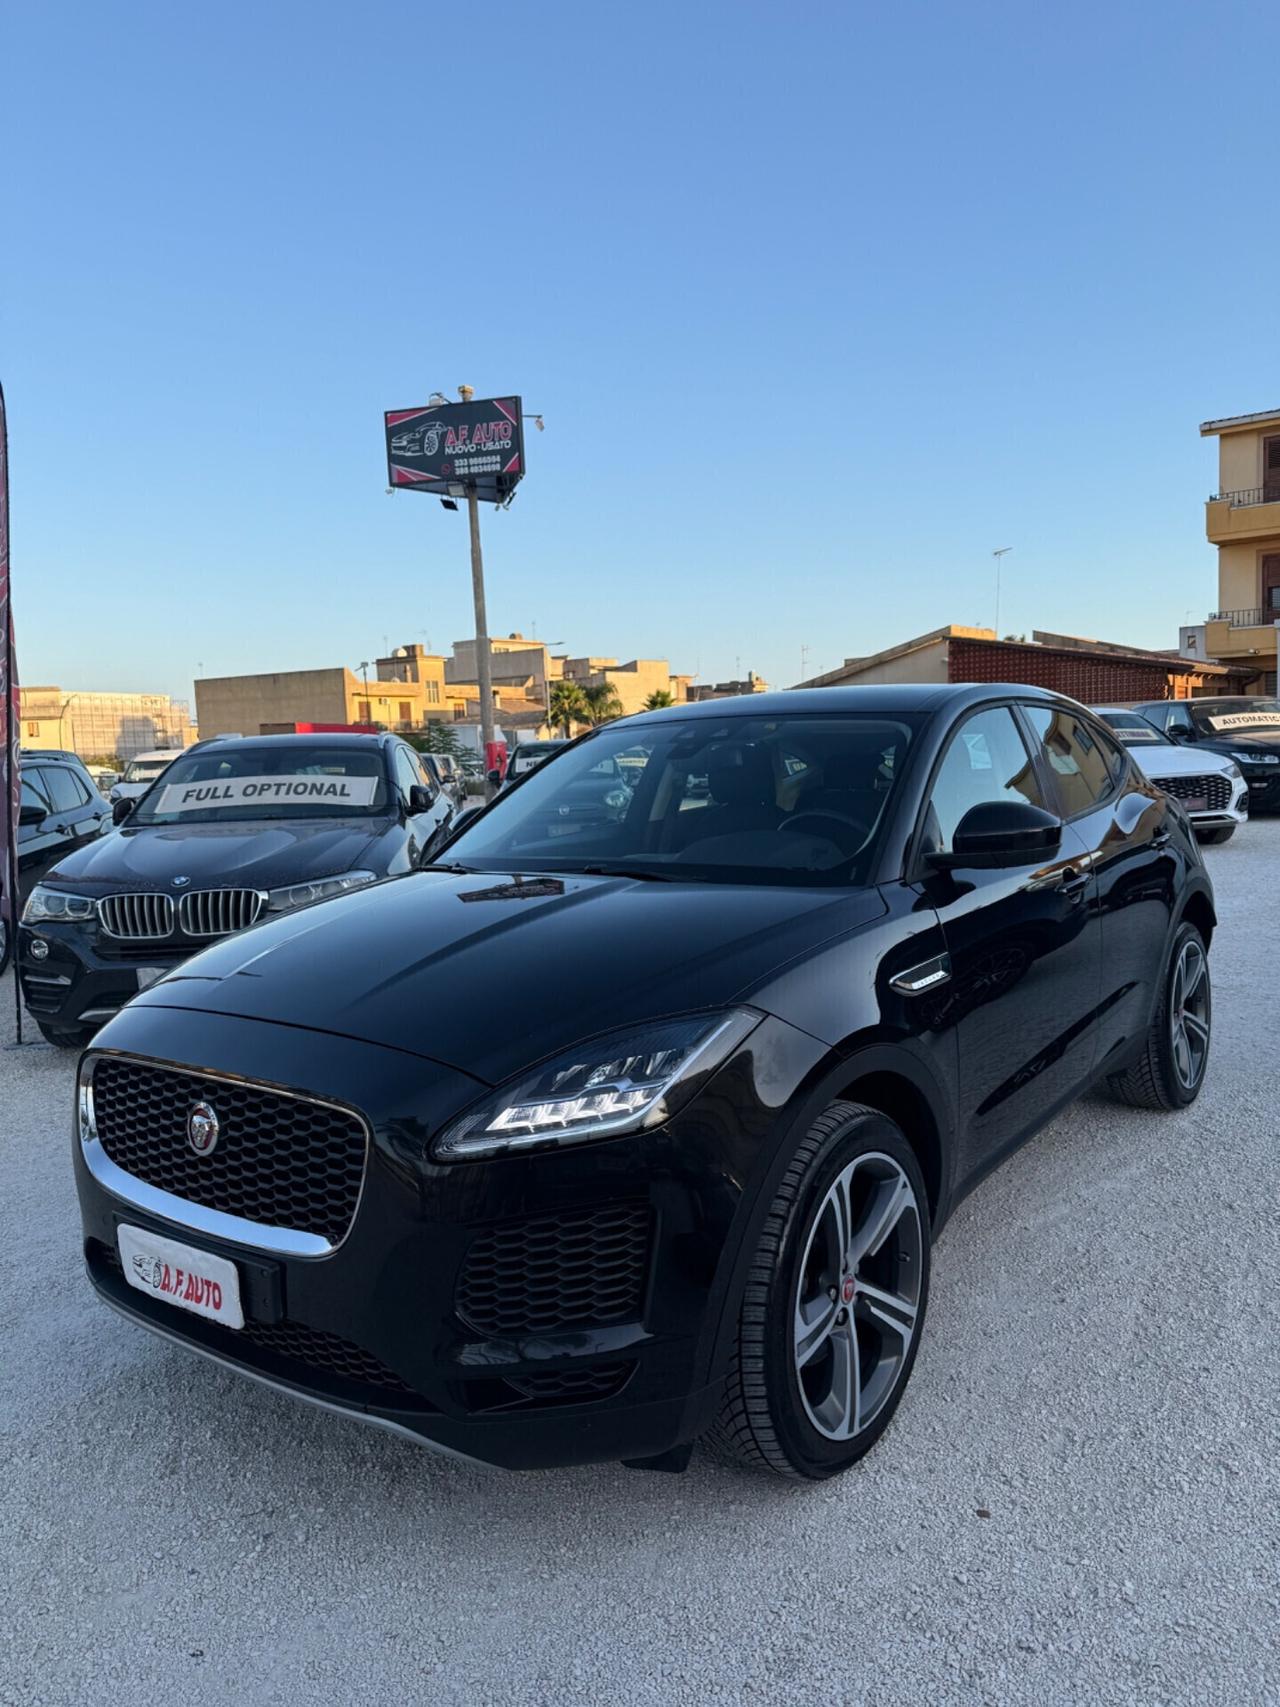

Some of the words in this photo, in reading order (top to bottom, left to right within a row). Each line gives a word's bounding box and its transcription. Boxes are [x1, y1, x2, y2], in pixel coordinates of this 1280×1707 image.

[472, 421, 512, 443] AUTO
[445, 444, 476, 455] NUOVO
[481, 440, 512, 451] USATO
[1222, 715, 1280, 725] AUTOMATIC
[182, 785, 234, 803] FULL
[242, 782, 351, 797] OPTIONAL
[184, 1273, 222, 1310] AUTO
